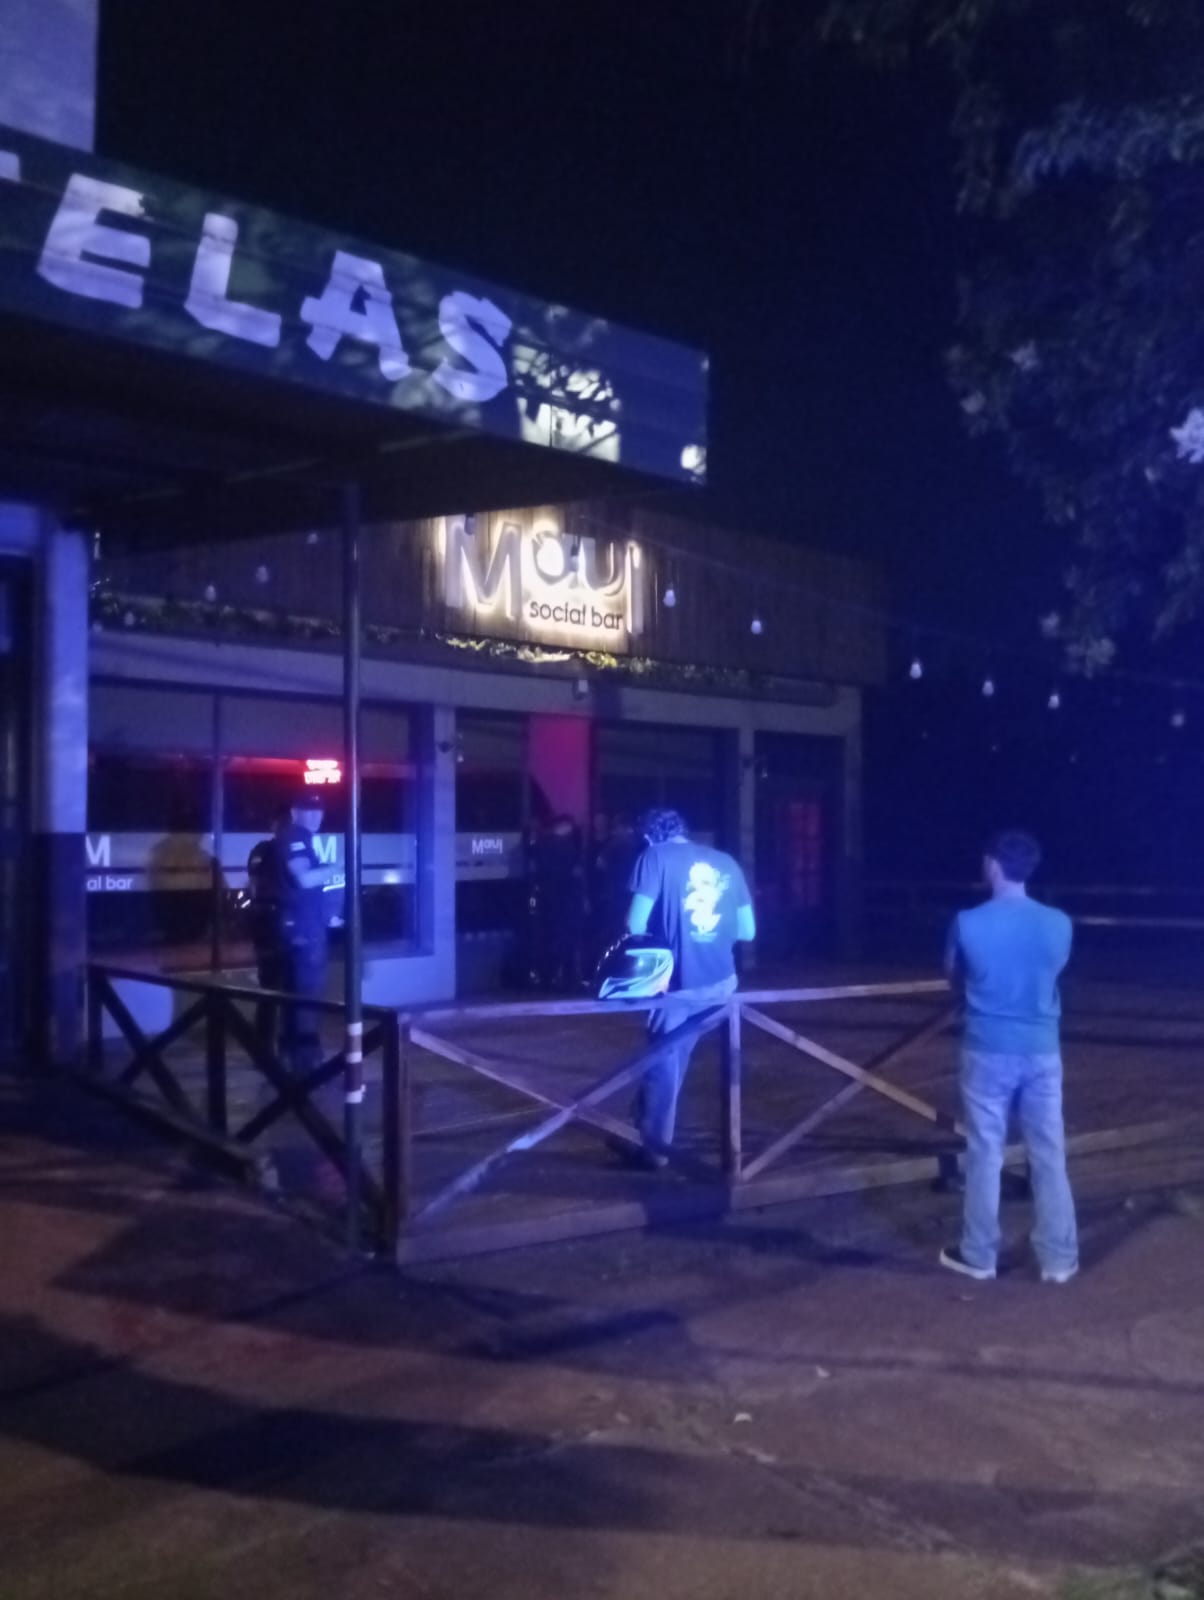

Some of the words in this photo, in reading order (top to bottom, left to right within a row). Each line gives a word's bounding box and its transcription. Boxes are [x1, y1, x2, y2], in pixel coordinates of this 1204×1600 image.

[0, 150, 512, 402] ELAS
[529, 600, 587, 626] social
[591, 605, 624, 631] bar
[106, 875, 133, 891] bar
